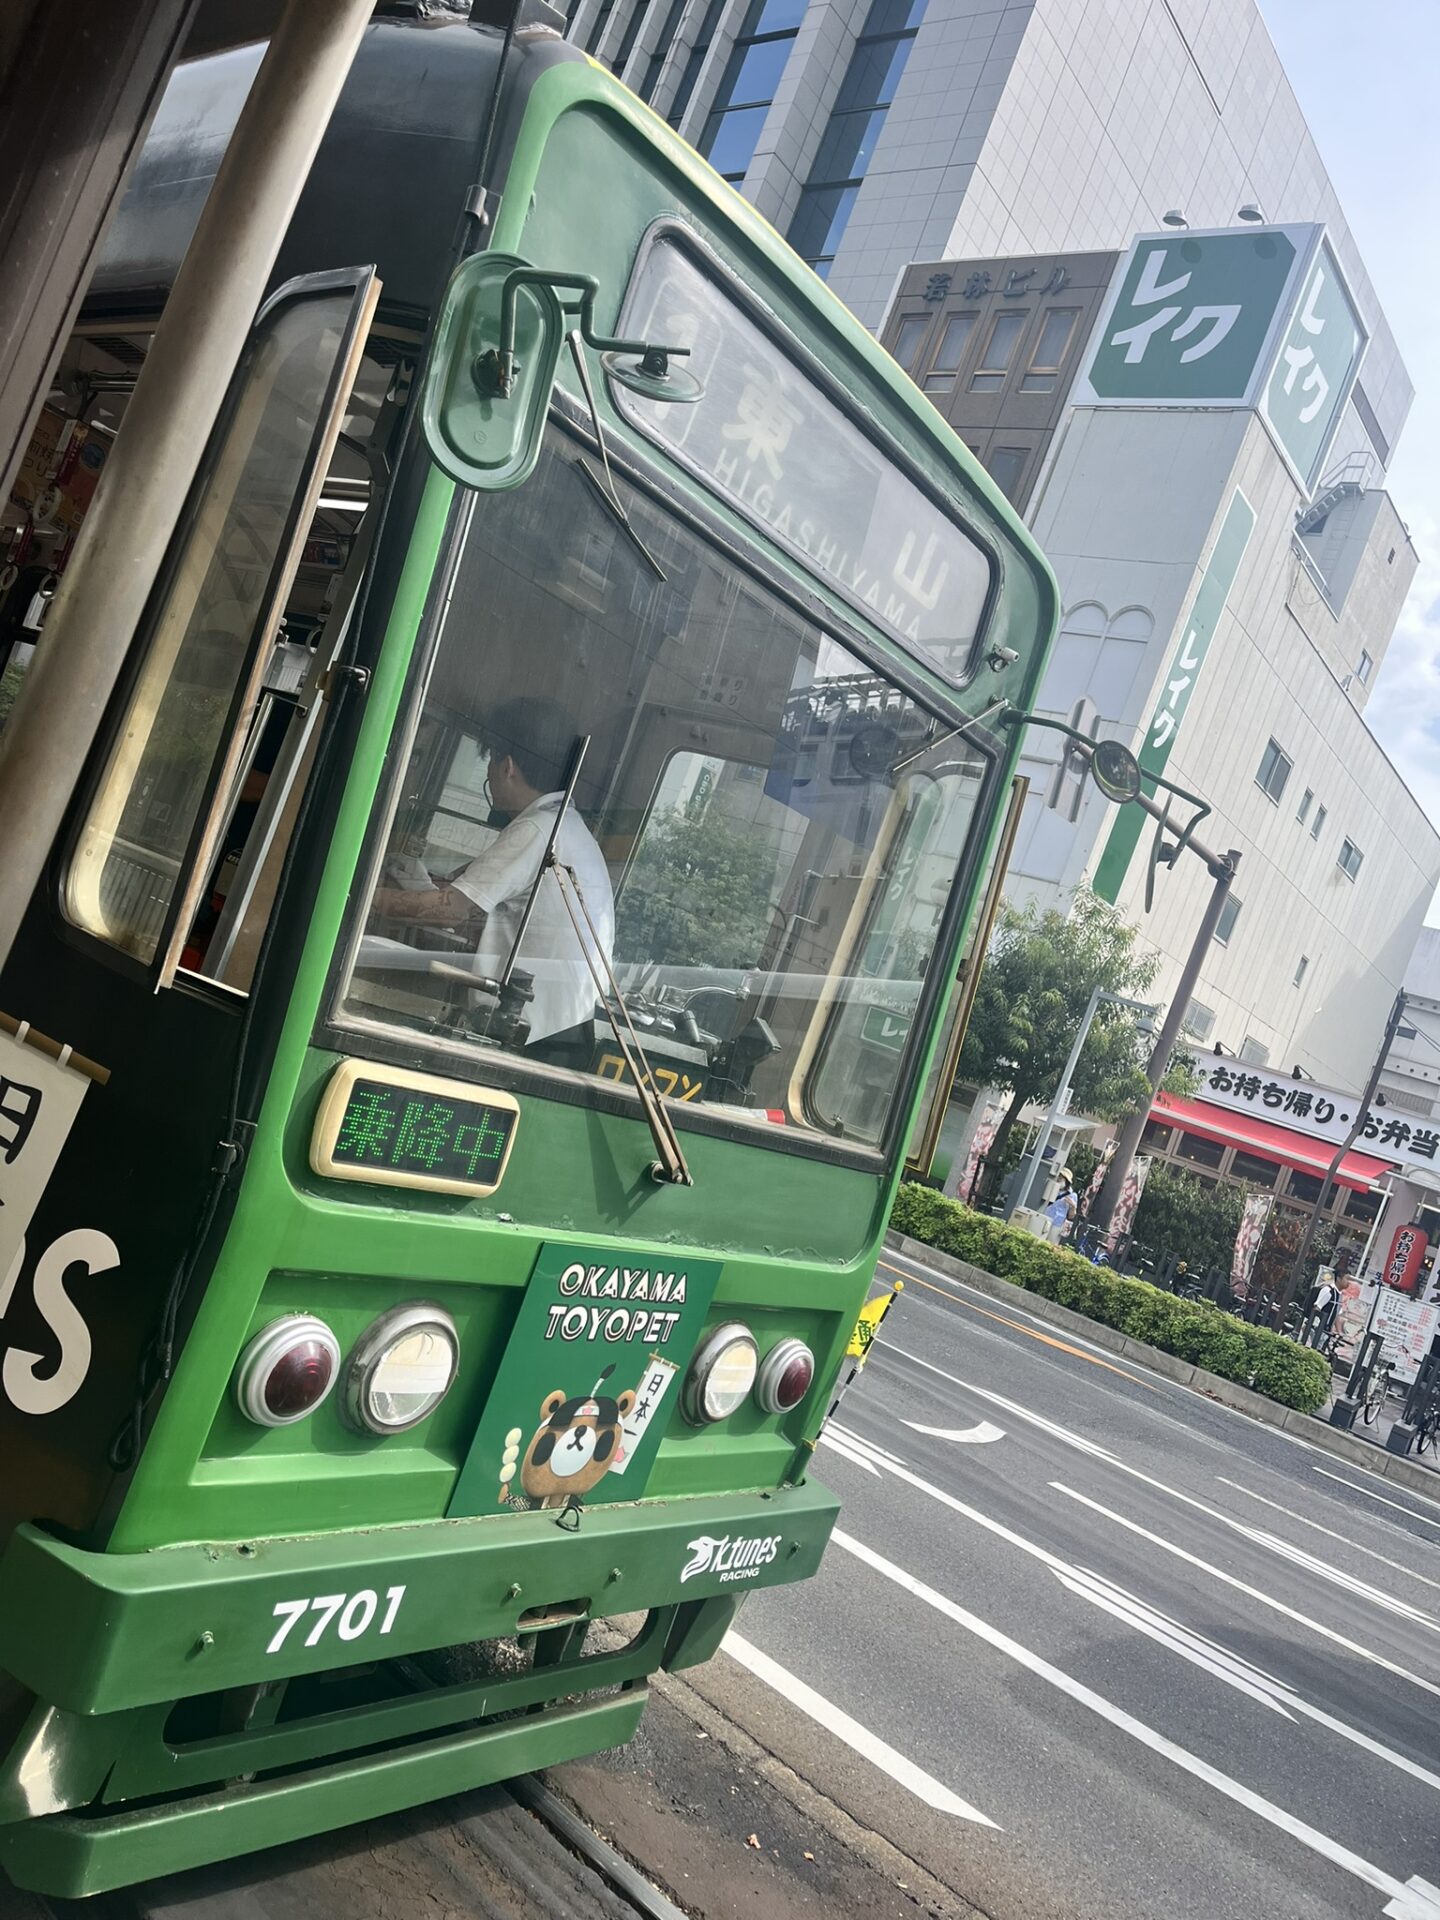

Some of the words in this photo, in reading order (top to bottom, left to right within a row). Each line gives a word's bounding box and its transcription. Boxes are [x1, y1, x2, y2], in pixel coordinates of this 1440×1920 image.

[923, 267, 1072, 301] 若林ビル
[1111, 250, 1242, 363] レイク
[1283, 266, 1329, 423] レイク
[712, 448, 921, 641] HIGASHIYAMA
[1153, 629, 1198, 748] レイク
[890, 846, 914, 900] レイク
[336, 1092, 505, 1175] 乗降中
[559, 1263, 688, 1304] OKAYAMA
[1390, 1230, 1416, 1283] お持ち帰り
[544, 1305, 681, 1344] TOYOPET
[624, 1374, 664, 1435] 日本一
[720, 1567, 760, 1582] RACING
[266, 1585, 407, 1654] 7701
